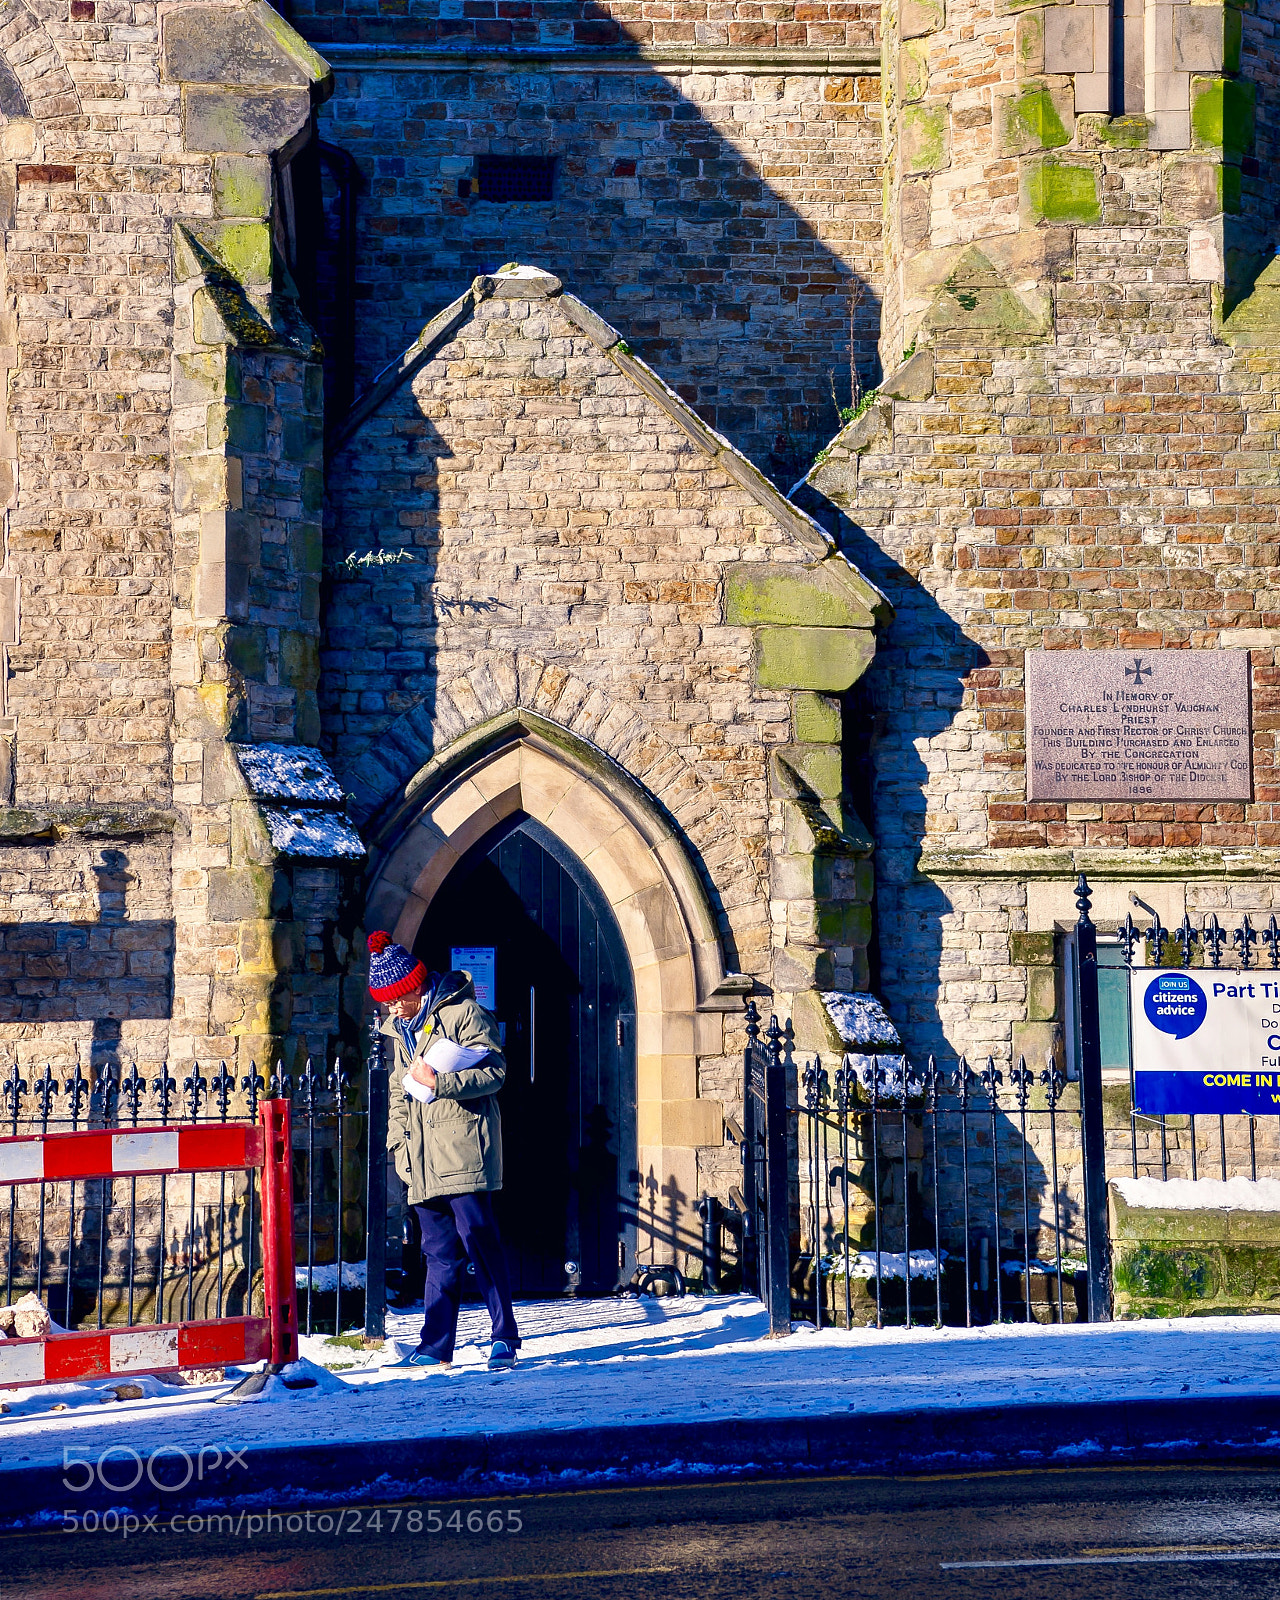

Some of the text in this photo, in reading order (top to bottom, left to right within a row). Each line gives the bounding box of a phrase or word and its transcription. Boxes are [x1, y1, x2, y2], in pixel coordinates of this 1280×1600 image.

[1103, 690, 1113, 701] IN
[1161, 693, 1174, 701] OF
[1059, 703, 1108, 713] CHARLES
[1121, 714, 1158, 724] PRIEST
[1033, 725, 1247, 736] FOUNDER AND FIRST RECTOR OF CHRIST CHURCH
[1041, 736, 1240, 748] THIS BUILDING PURCHASED AND ENLARGED
[1081, 748, 1199, 759] BY THE CONGREGATION
[1034, 760, 1053, 771] WAS
[1055, 762, 1101, 771] DEDICATED
[1105, 762, 1116, 771] TO
[1136, 762, 1170, 770] HONOUR
[1171, 762, 1183, 770] OF
[1230, 759, 1248, 770] GOD
[1055, 771, 1069, 782] BY
[1071, 774, 1089, 782] THE
[1093, 771, 1117, 782] LORD
[1154, 774, 1166, 782] OF
[1169, 774, 1187, 782] THE
[1128, 786, 1153, 794] 1896
[1213, 981, 1279, 998] Part Ti
[1152, 991, 1198, 1003] citizens
[1156, 1004, 1196, 1015] advice
[1261, 1018, 1279, 1028] Do
[1203, 1074, 1252, 1087] COME
[1255, 1074, 1273, 1087] IN
